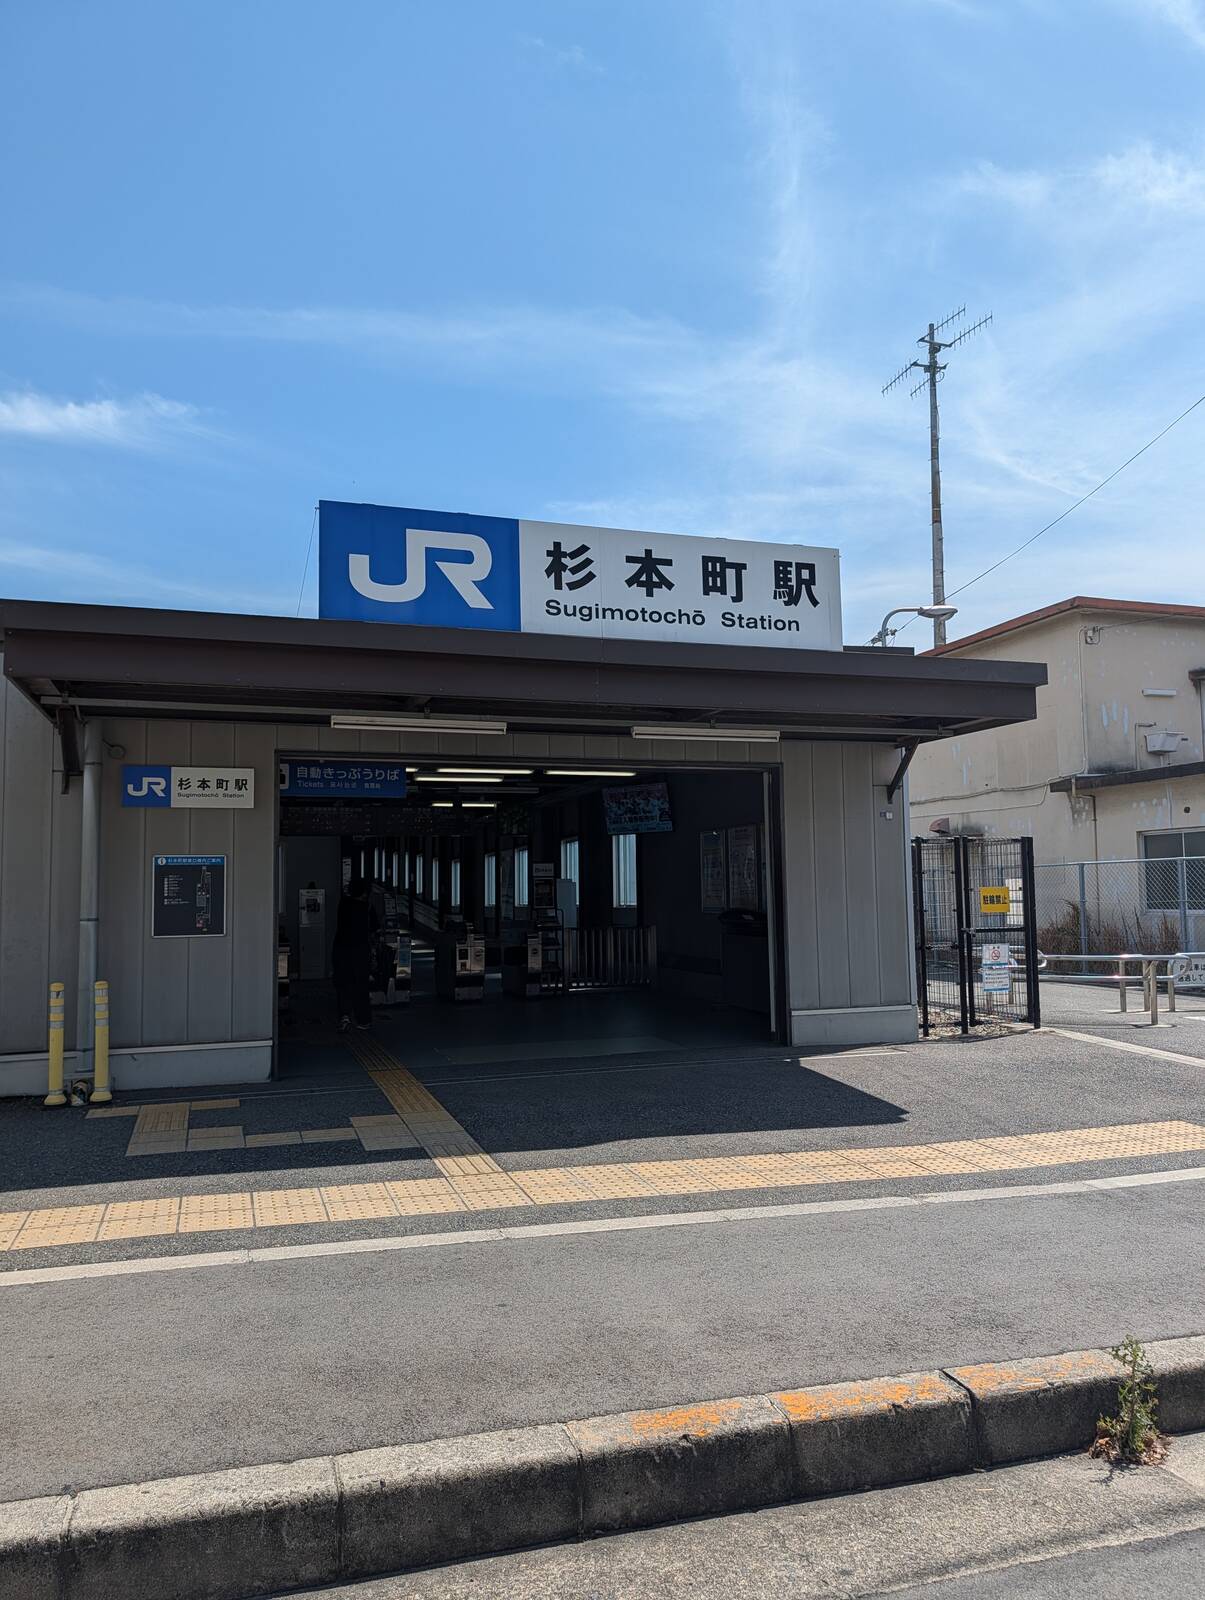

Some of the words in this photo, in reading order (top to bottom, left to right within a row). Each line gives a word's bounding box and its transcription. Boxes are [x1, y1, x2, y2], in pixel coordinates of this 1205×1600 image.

[348, 528, 495, 609] JR
[544, 541, 820, 608] 杉本町駅
[545, 599, 706, 626] Sugimotochō
[721, 612, 800, 632] Station
[127, 776, 167, 797] JR
[177, 778, 249, 791] 杉本町駅
[296, 766, 400, 781] 自動きっぷうりば
